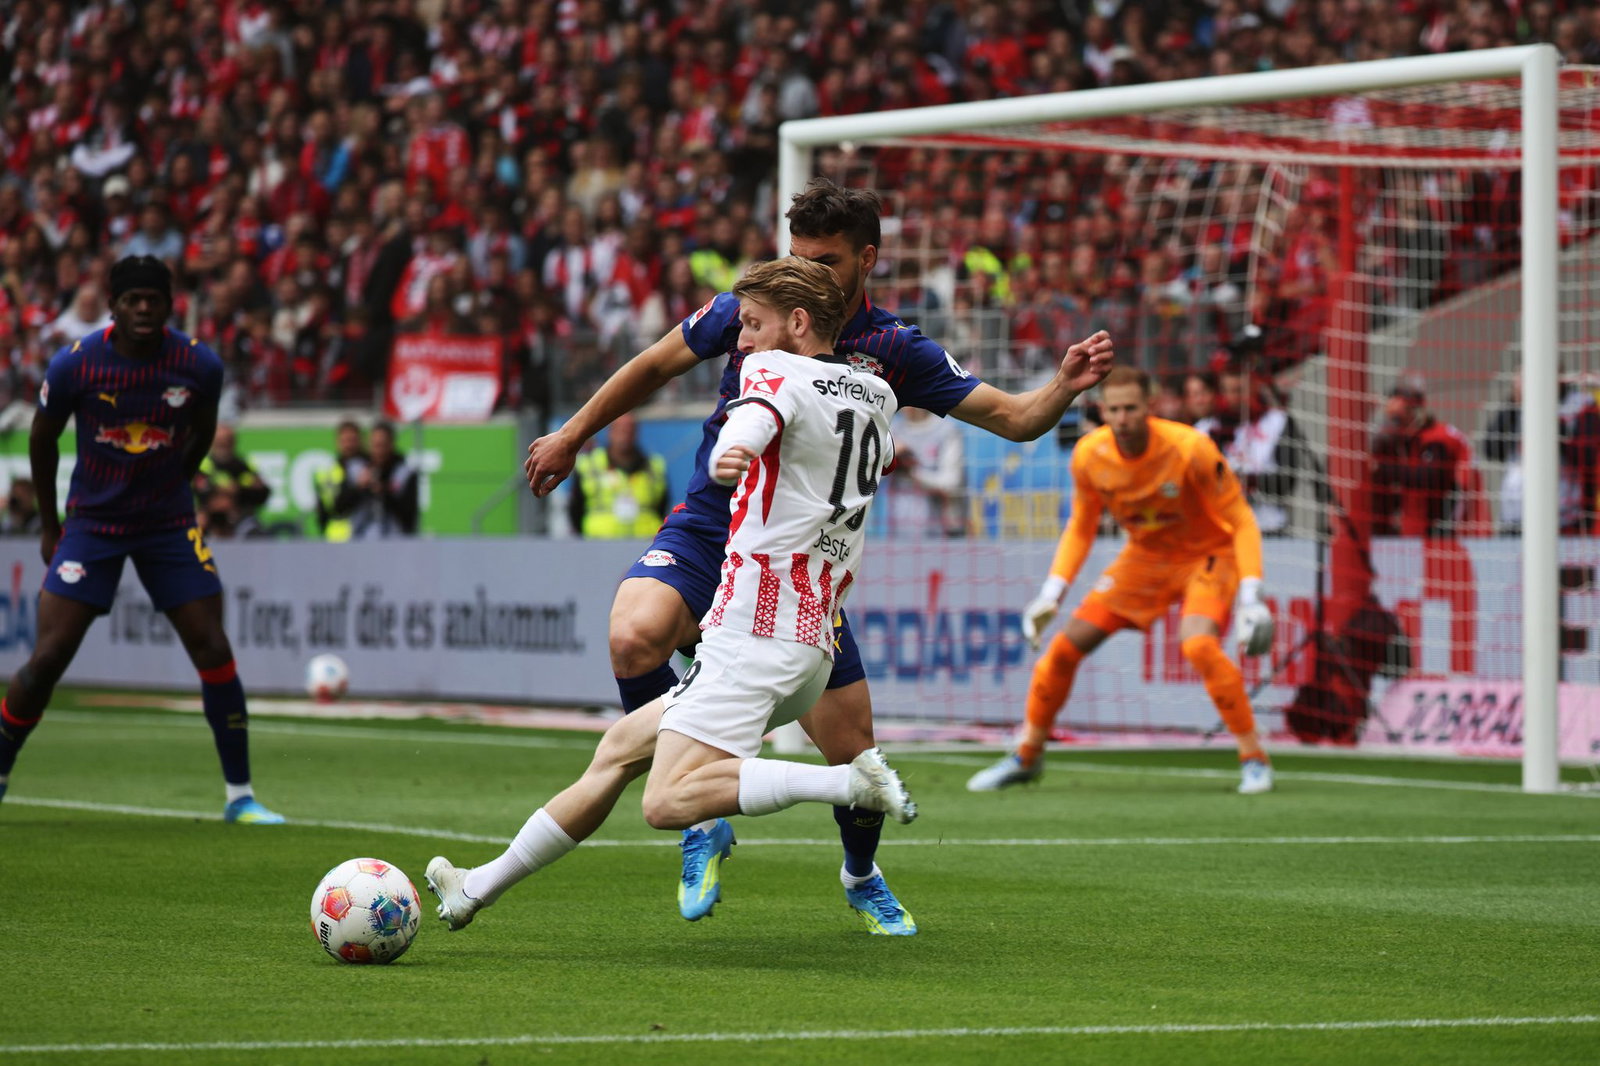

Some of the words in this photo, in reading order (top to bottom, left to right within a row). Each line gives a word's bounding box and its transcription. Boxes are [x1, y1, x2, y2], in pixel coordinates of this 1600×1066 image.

[306, 586, 349, 650] auf
[356, 586, 398, 650] die
[404, 601, 434, 650] es
[672, 660, 702, 698] 9
